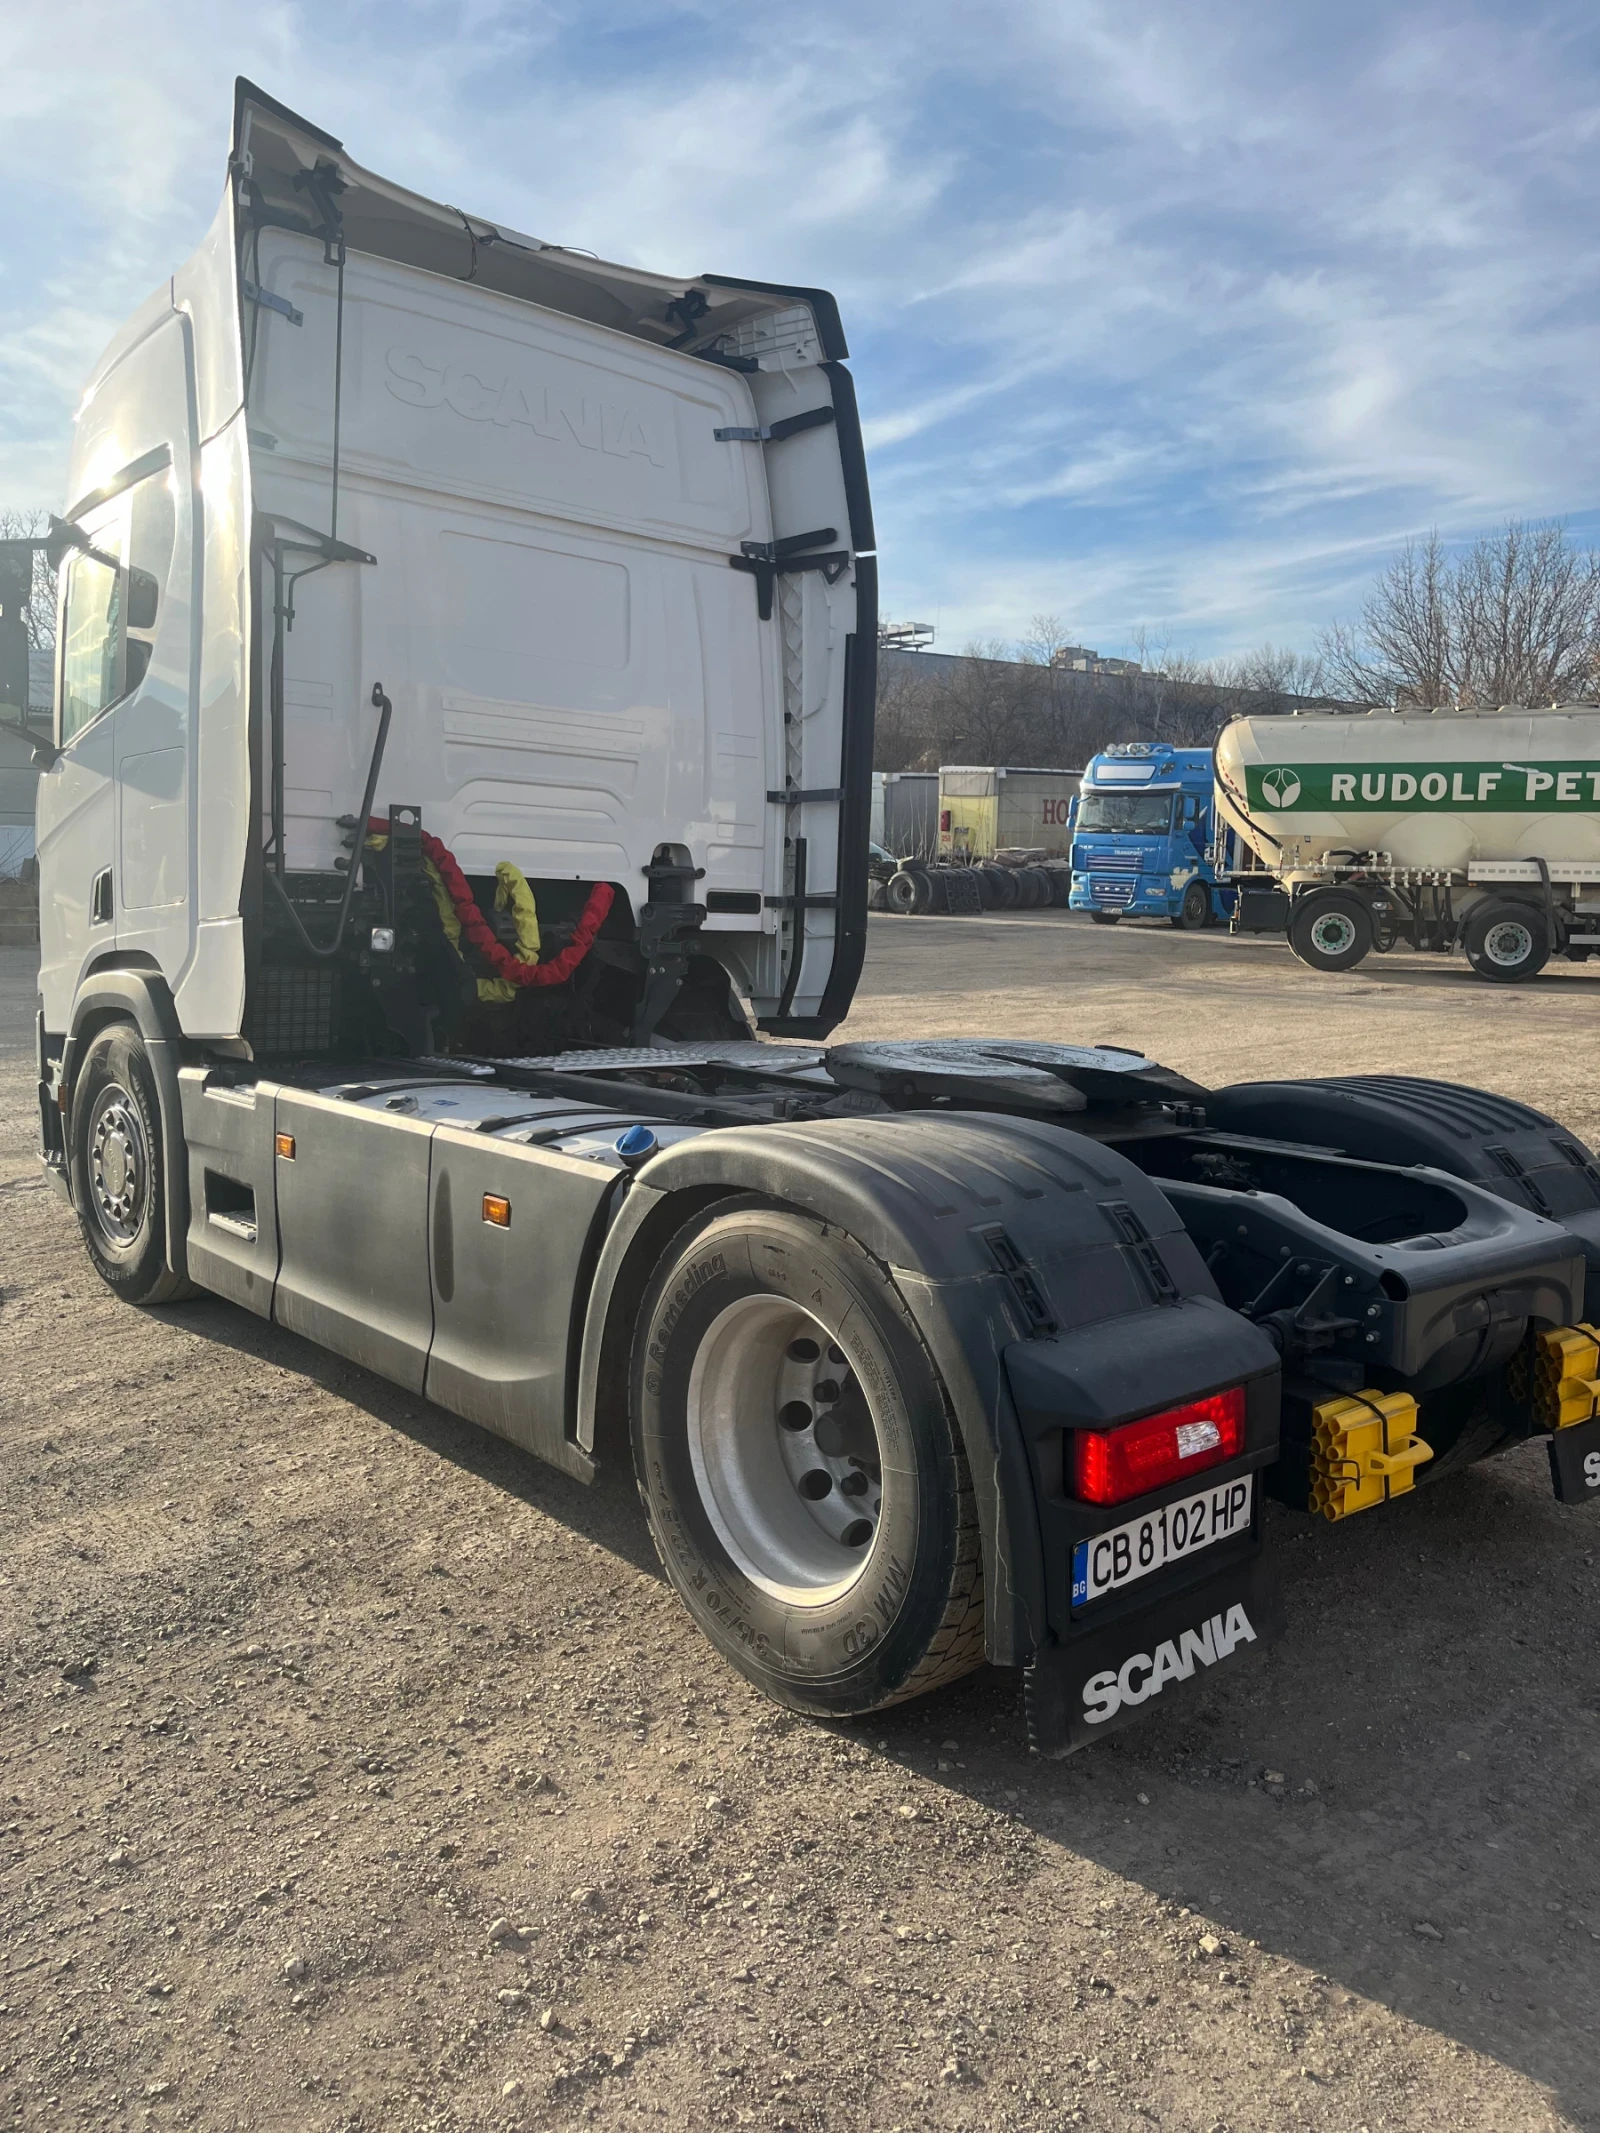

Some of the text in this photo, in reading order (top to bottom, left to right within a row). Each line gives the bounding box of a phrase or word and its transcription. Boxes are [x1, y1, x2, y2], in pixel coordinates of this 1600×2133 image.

[384, 346, 665, 469] SCANIA
[1331, 772, 1502, 802] RUDOLF
[661, 1505, 697, 1567] 22.5
[1093, 1483, 1247, 1588] CB 8102 HP
[690, 1567, 708, 1592] R
[843, 1554, 907, 1656] MM 3D
[1072, 1580, 1086, 1598] BG
[706, 1589, 770, 1657] 315/70
[1082, 1602, 1258, 1725] SCANIA
